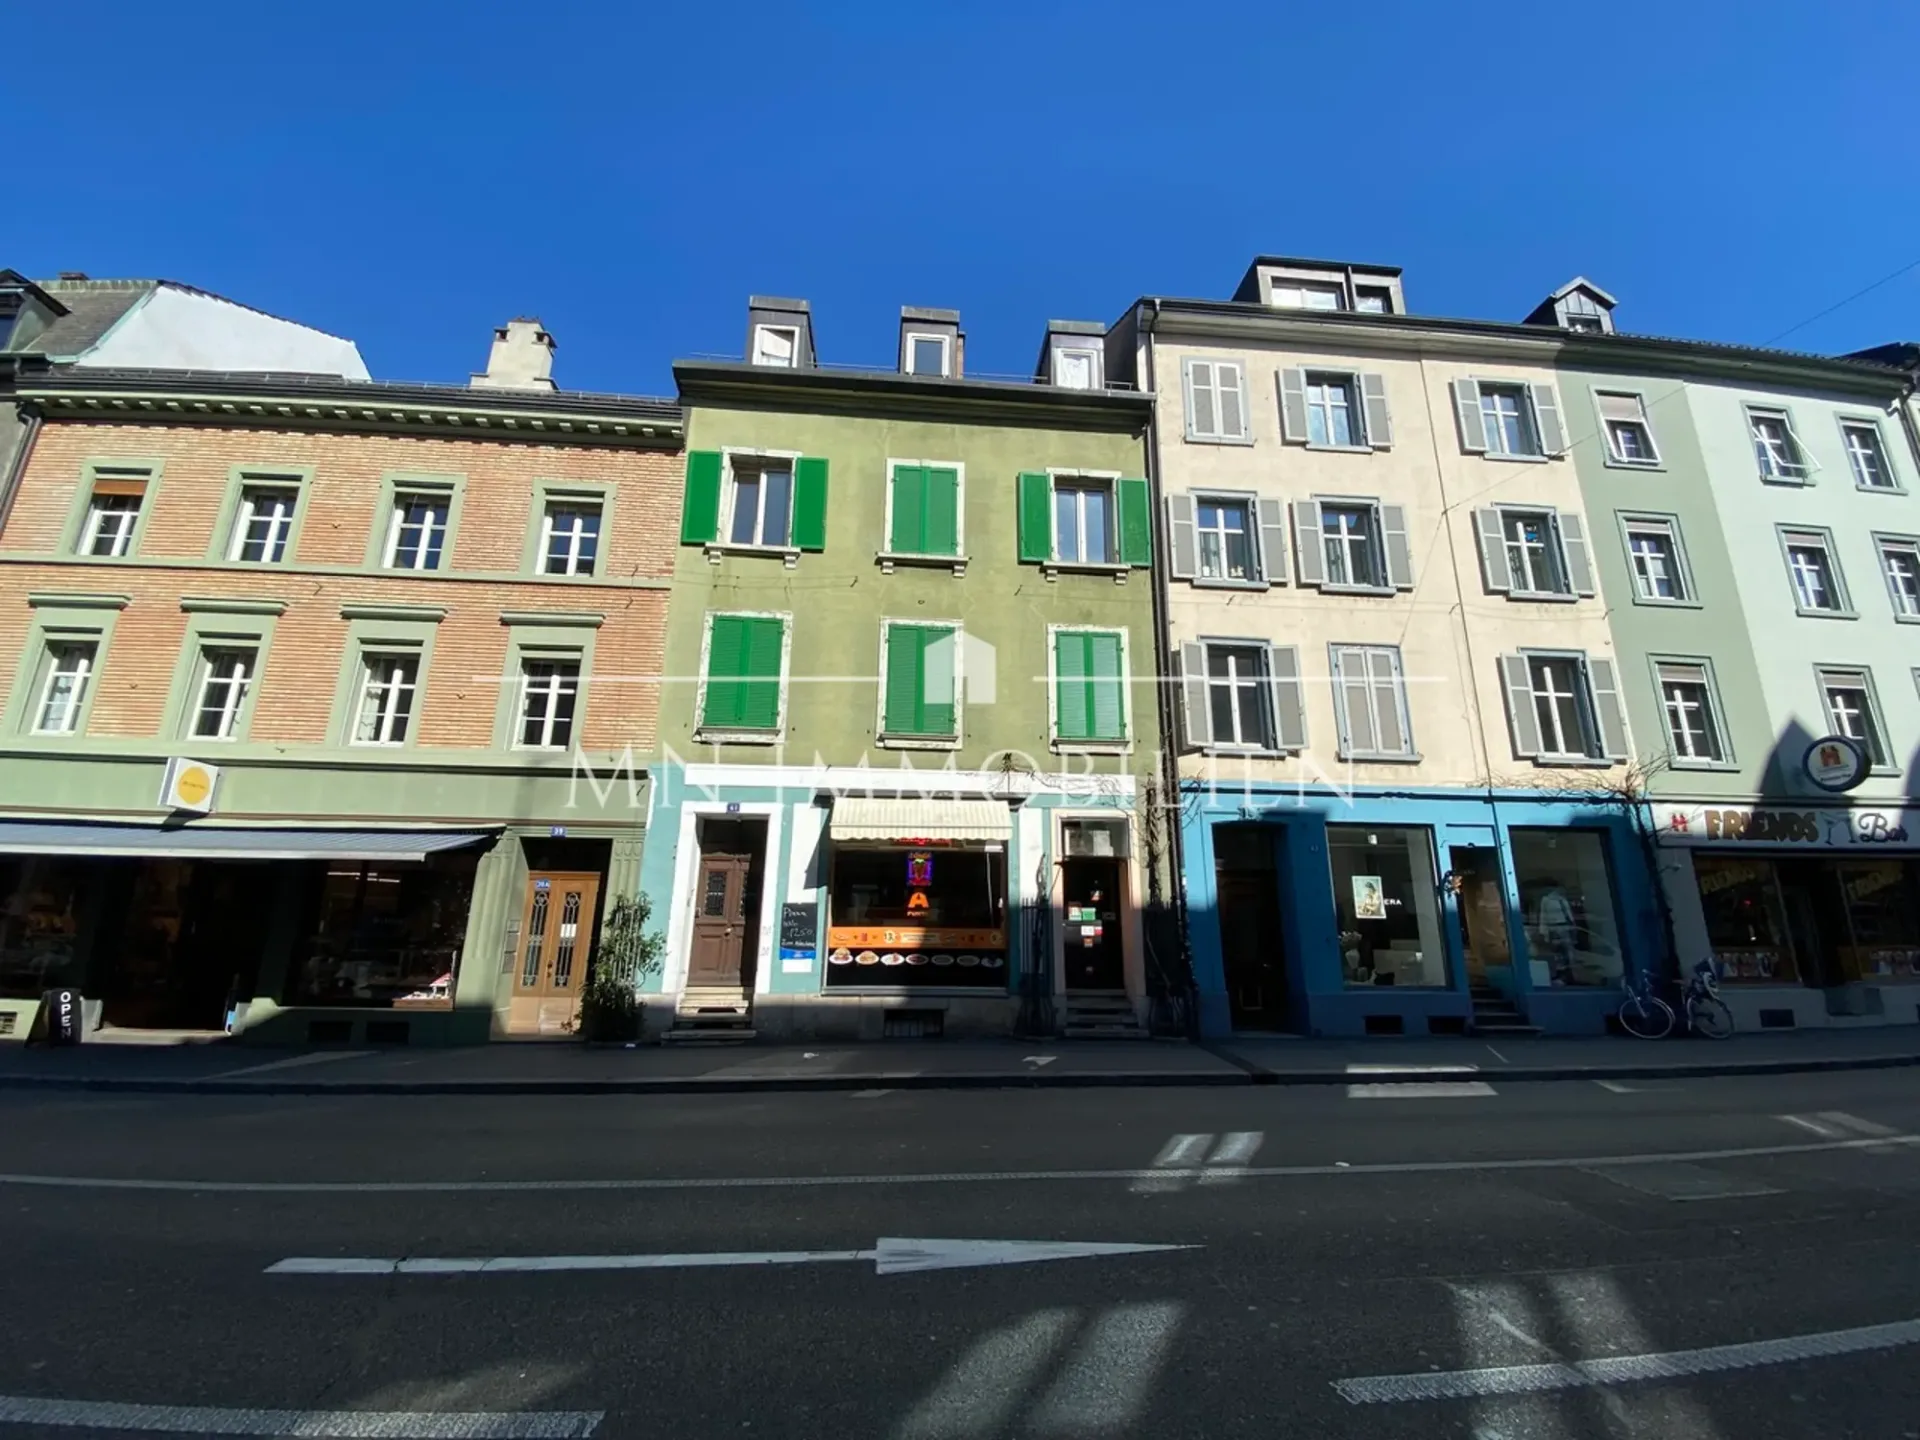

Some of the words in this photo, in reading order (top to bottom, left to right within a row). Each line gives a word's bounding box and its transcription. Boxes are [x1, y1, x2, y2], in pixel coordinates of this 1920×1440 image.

[1704, 809, 1819, 842] FRIENDS
[1858, 812, 1909, 842] Bar
[60, 991, 71, 1038] OPEN
